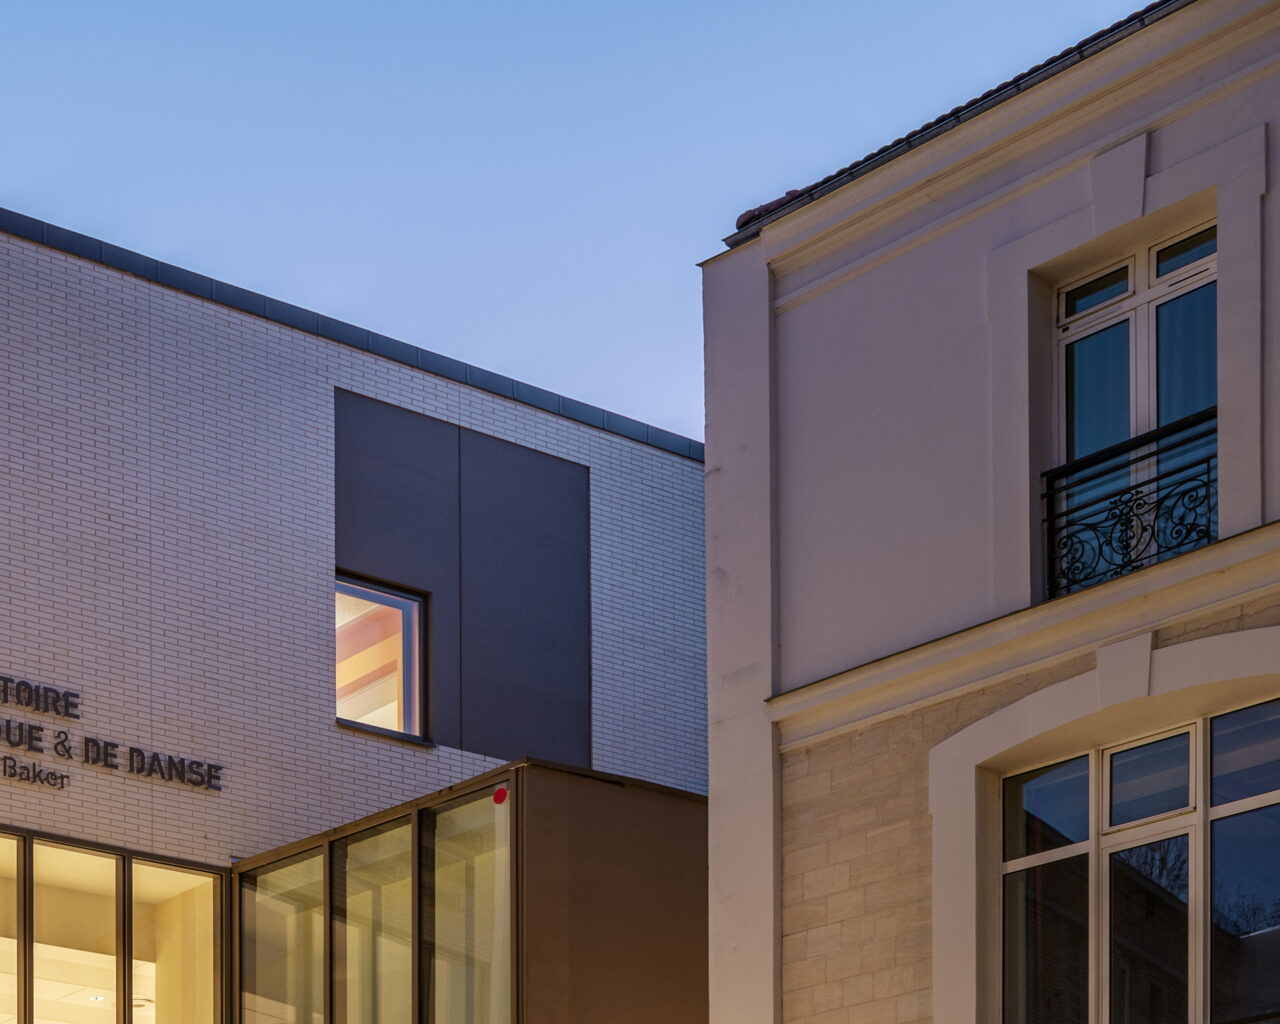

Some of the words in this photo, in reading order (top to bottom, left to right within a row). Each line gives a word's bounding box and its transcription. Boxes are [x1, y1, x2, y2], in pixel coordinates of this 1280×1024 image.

[2, 755, 70, 790] Baker
[53, 731, 74, 759] &
[82, 736, 119, 769] DE
[128, 746, 223, 791] DANSE
